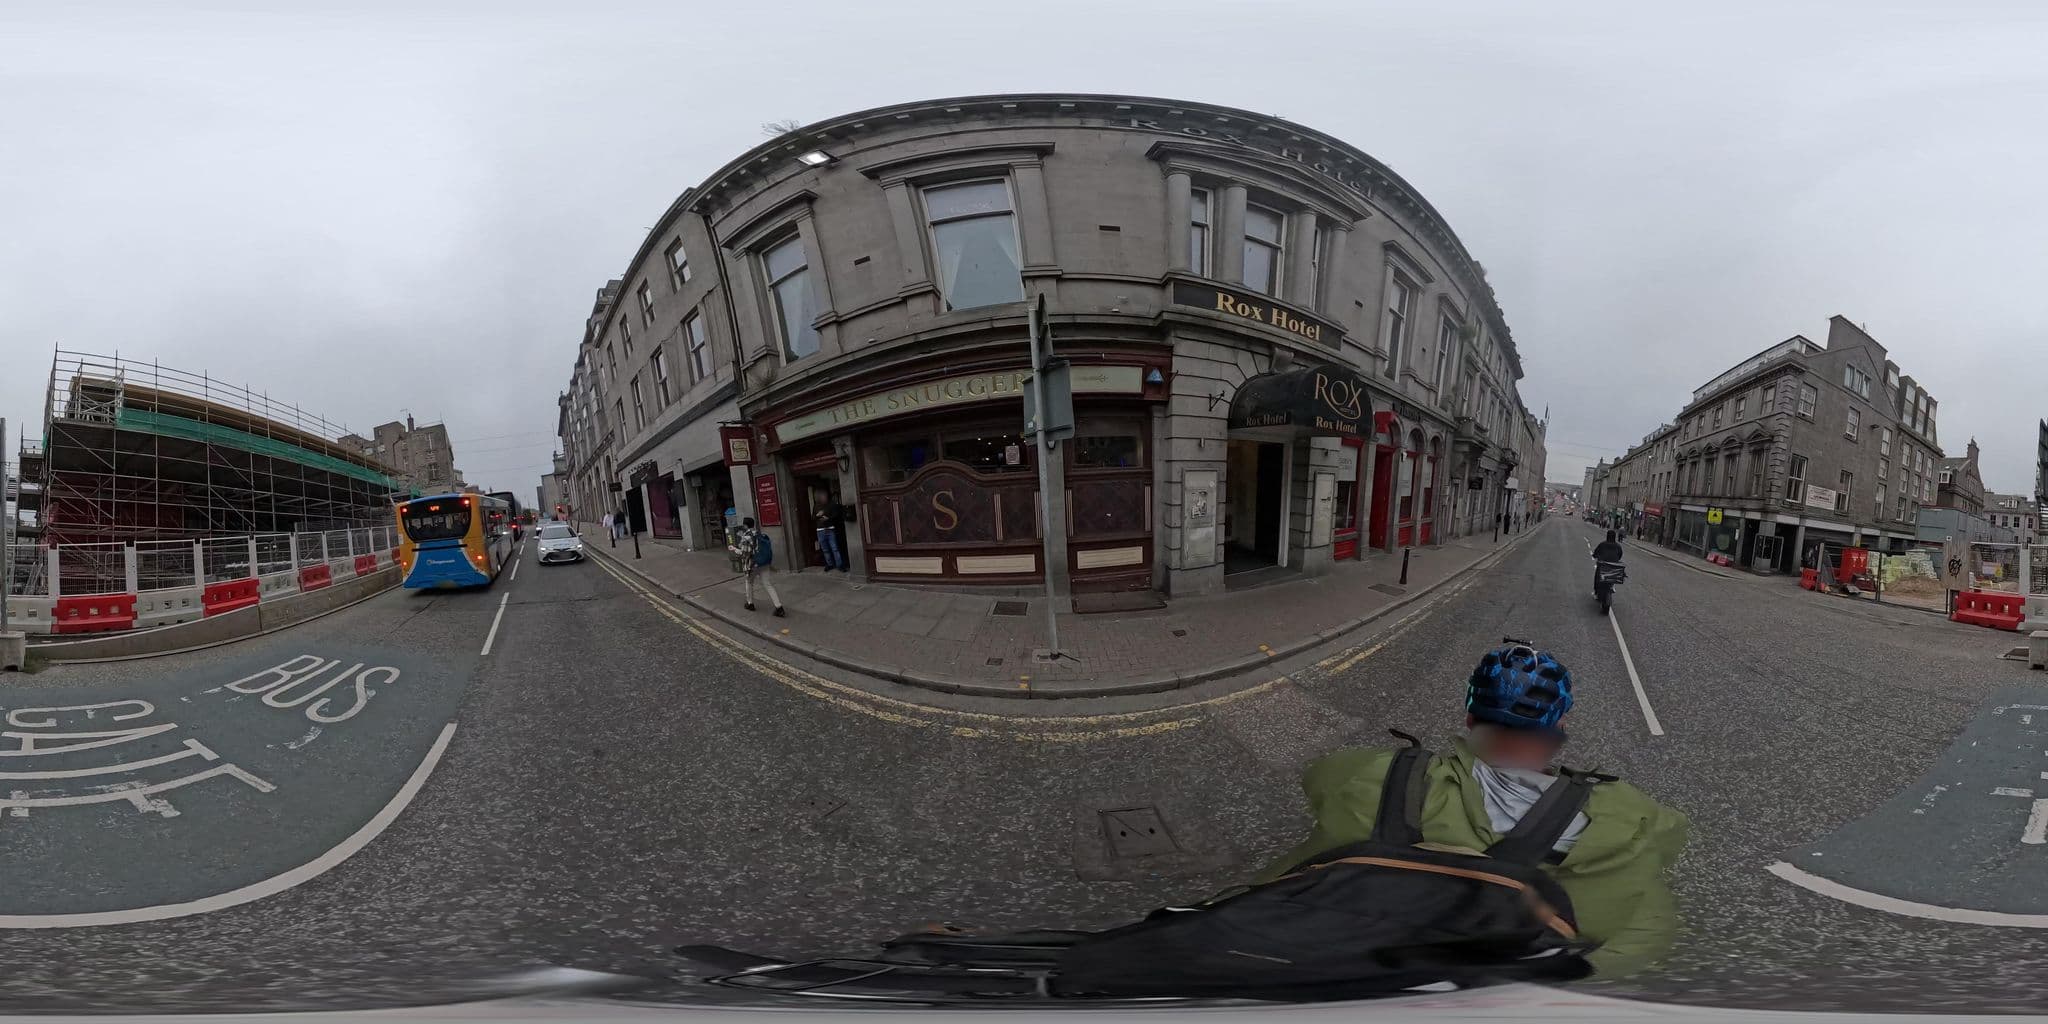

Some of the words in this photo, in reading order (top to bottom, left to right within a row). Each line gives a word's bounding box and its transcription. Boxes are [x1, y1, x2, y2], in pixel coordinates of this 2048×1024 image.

[1216, 291, 1264, 321] Rox
[1271, 307, 1320, 341] Hotel
[828, 400, 876, 425] THE
[1316, 416, 1333, 430] Rox
[1336, 420, 1357, 434] Hotel
[932, 488, 958, 531] S
[224, 654, 400, 723] BUS
